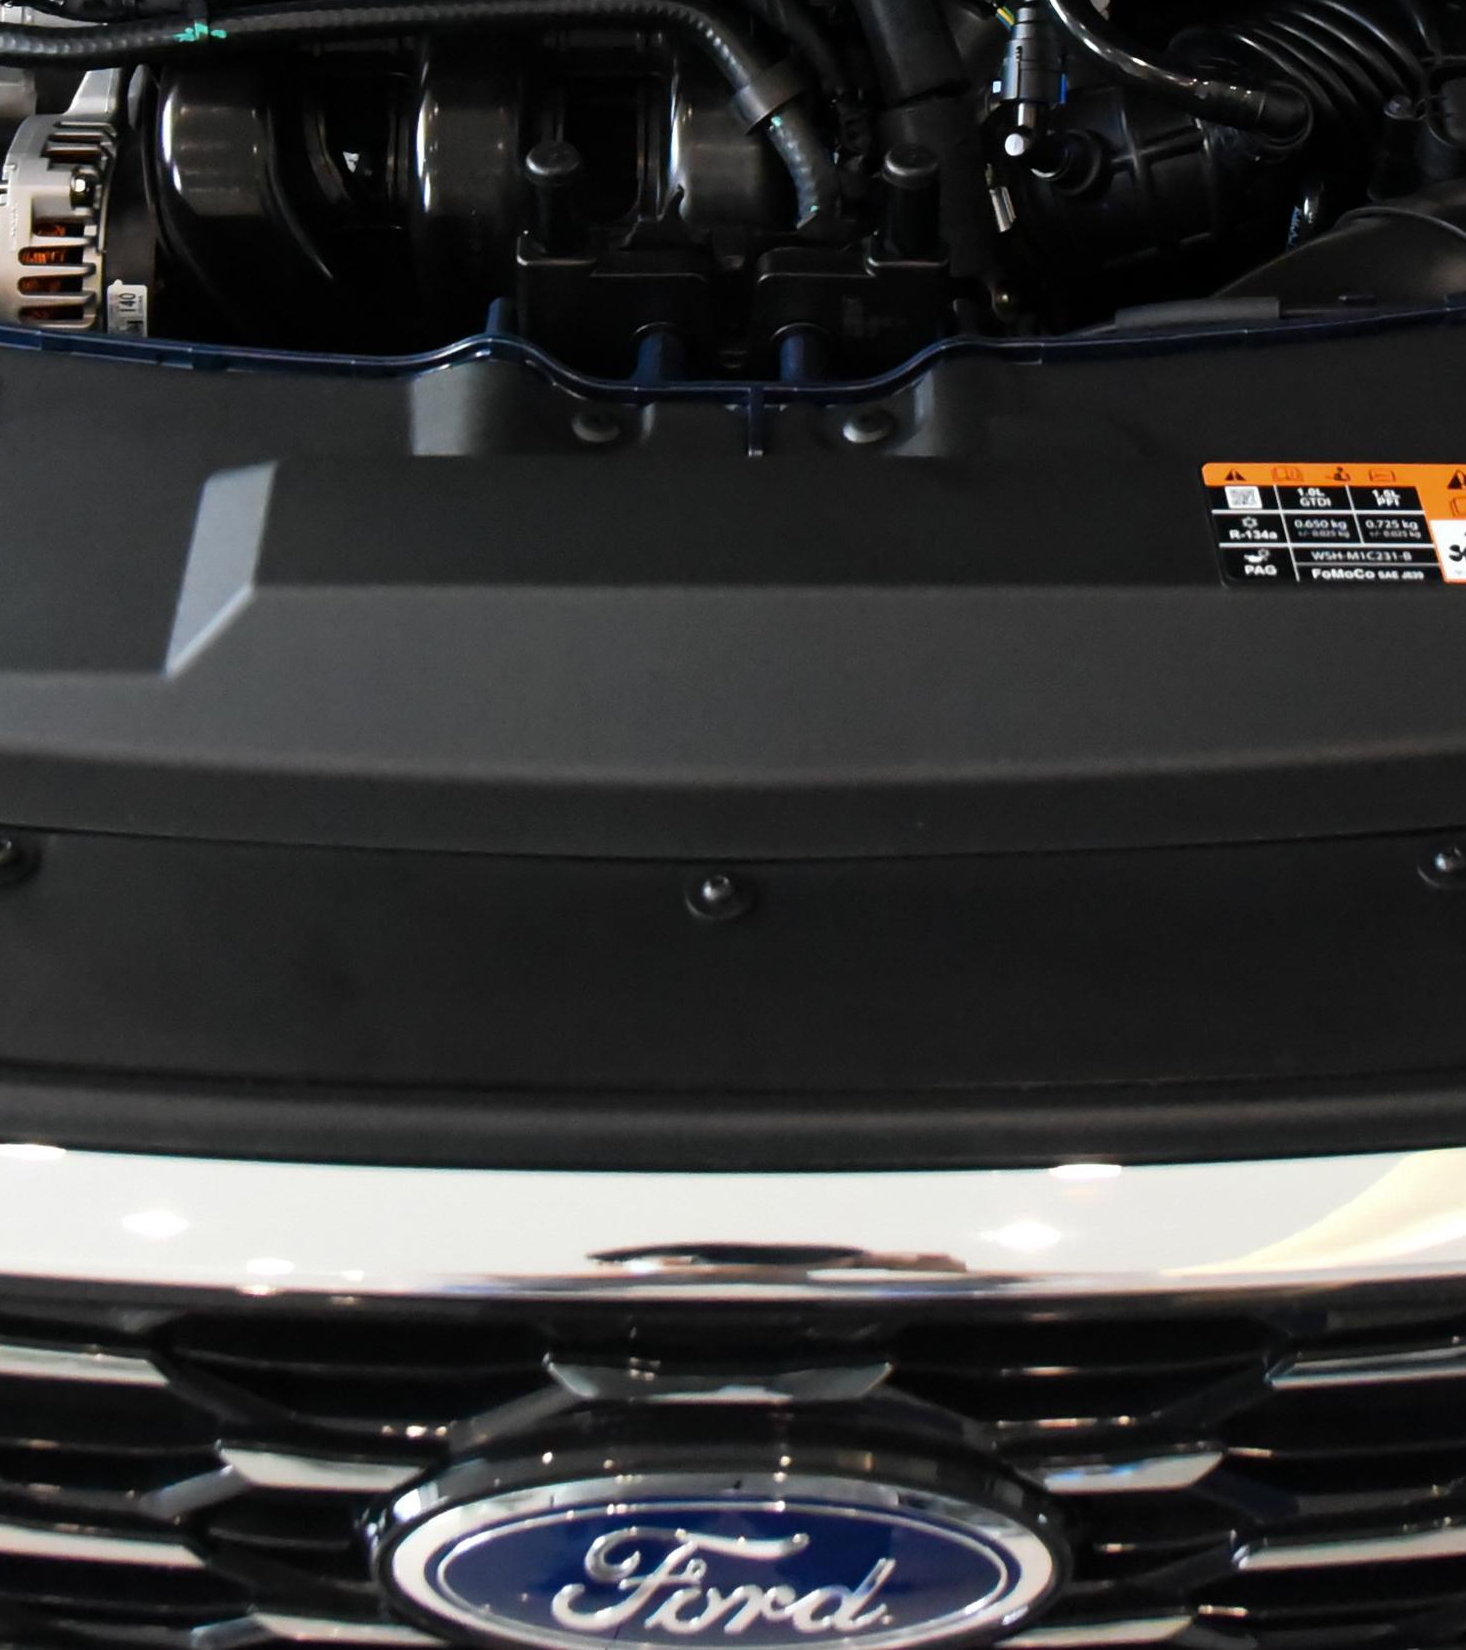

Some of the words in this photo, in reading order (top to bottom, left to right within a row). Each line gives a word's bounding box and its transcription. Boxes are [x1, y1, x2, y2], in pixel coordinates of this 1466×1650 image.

[1299, 497, 1332, 507] GTDI
[1330, 519, 1348, 531] kg
[1365, 519, 1399, 529] 0.725
[1401, 520, 1419, 531] kg
[1229, 530, 1278, 540] R-134a
[1244, 565, 1278, 576] PAG
[1311, 569, 1375, 580] FoMoCo
[551, 1526, 894, 1634] Ford
